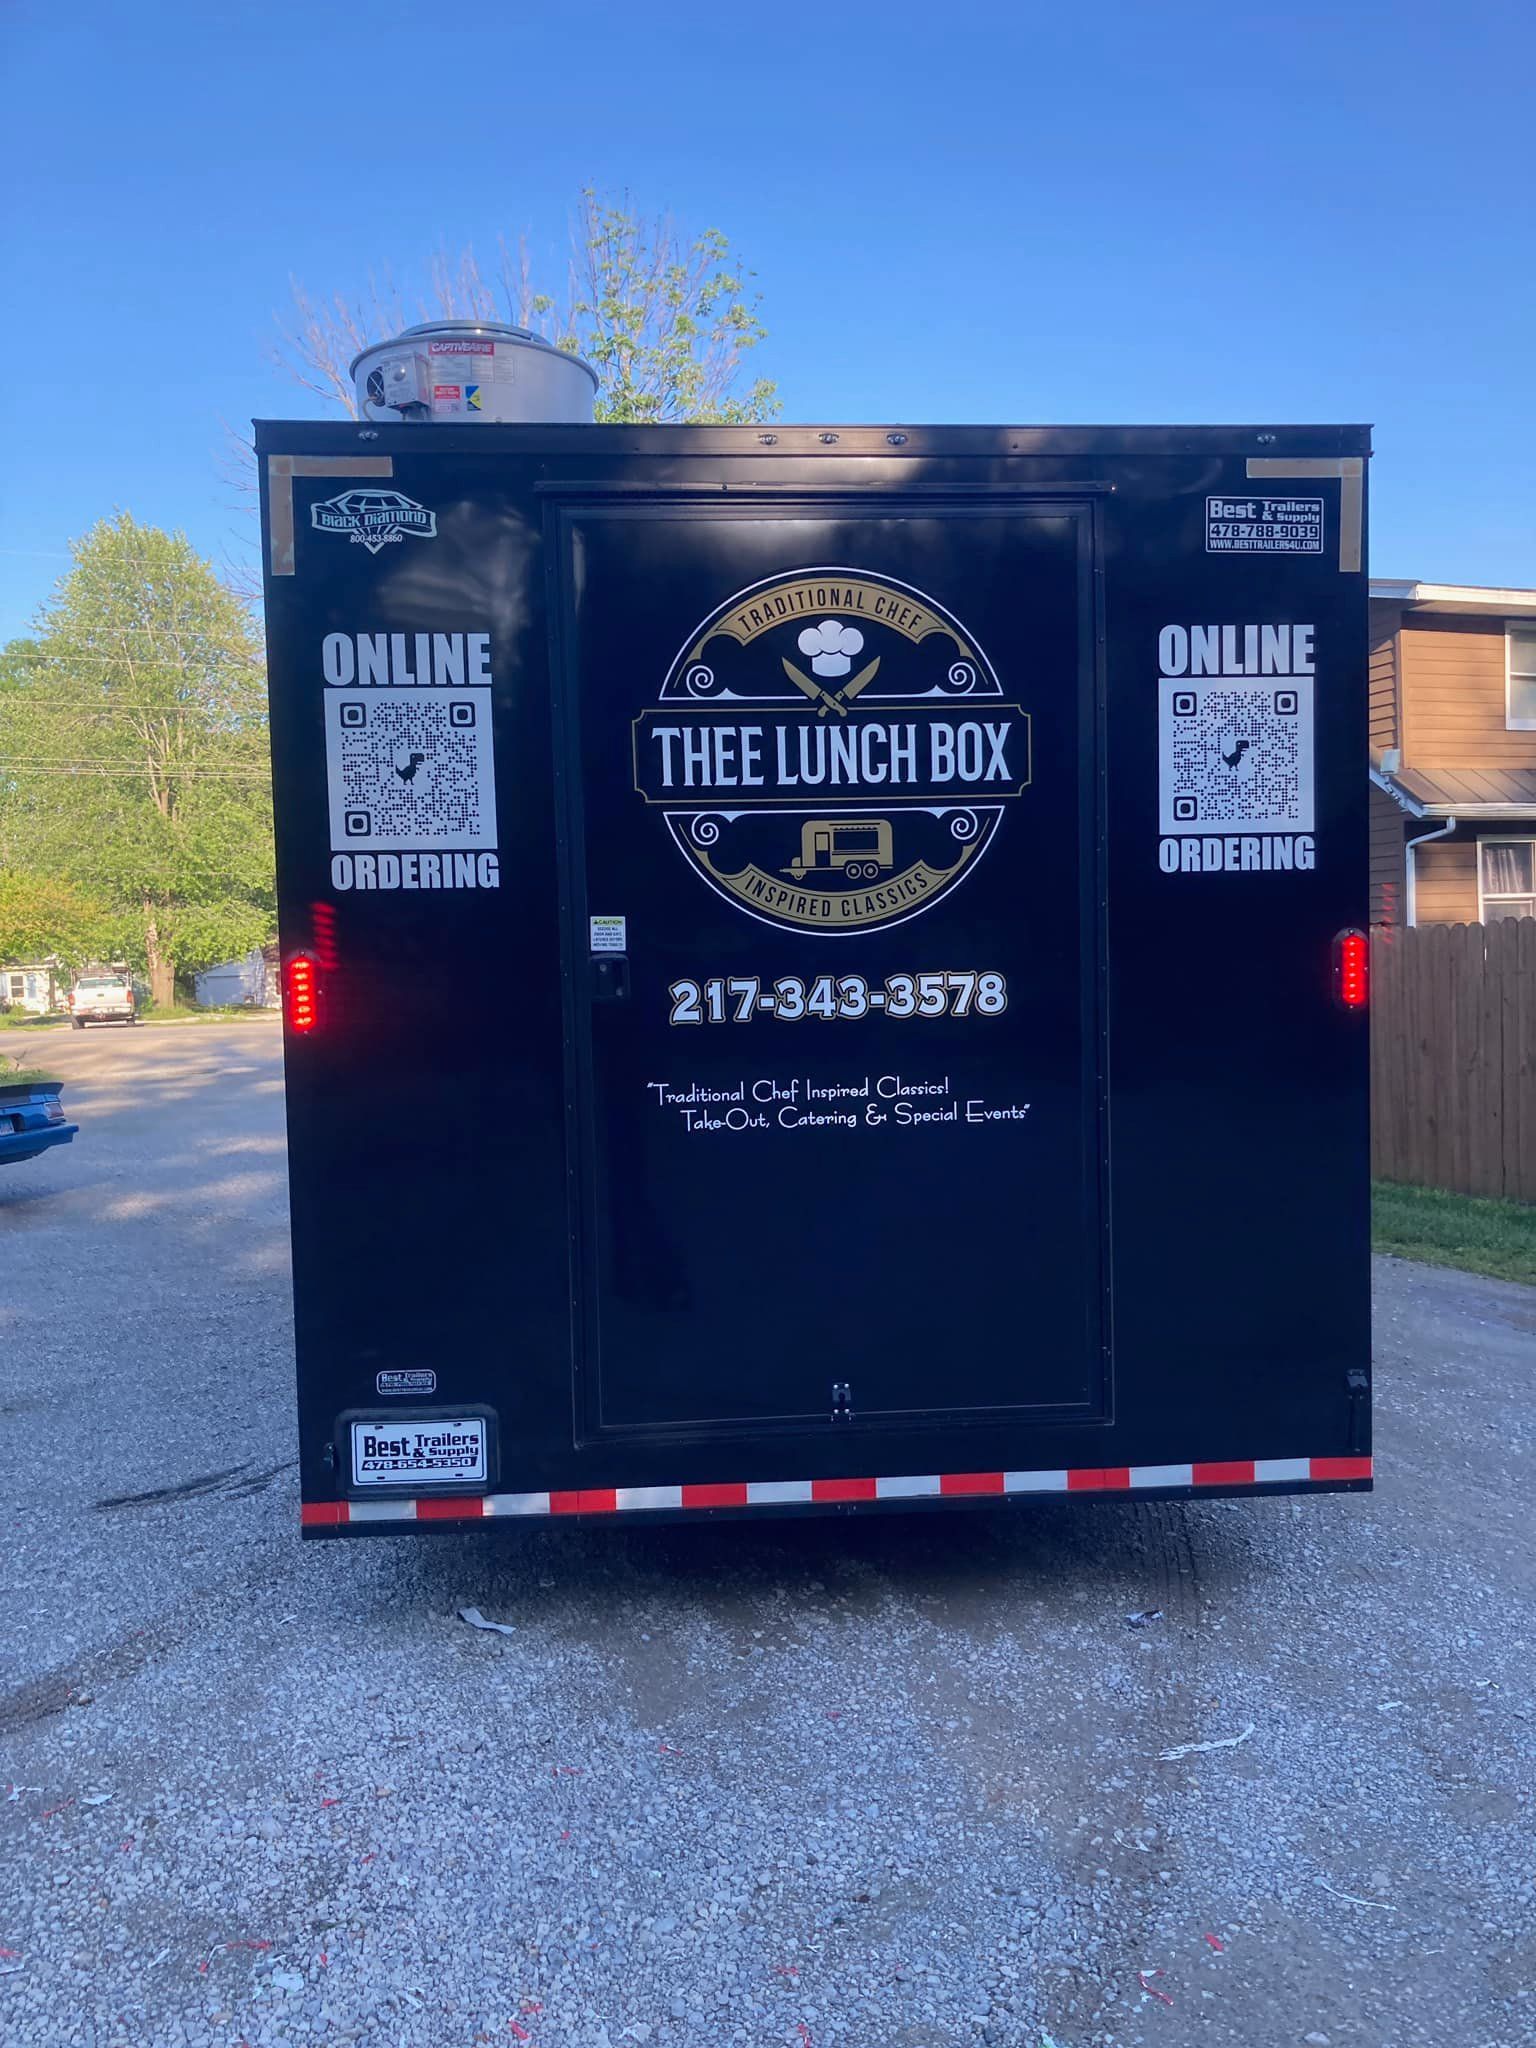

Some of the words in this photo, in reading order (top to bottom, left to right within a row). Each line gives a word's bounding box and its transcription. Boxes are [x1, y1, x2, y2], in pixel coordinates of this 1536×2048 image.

[1210, 500, 1256, 518] Best
[1262, 501, 1320, 512] Trailers
[1262, 511, 1273, 520] &
[1277, 512, 1320, 523] Supply
[1210, 524, 1319, 538] 478-788-9039
[1210, 540, 1320, 550] WWW.BESTTRAILERS4U.COM
[738, 588, 865, 633] TRADITIONAL
[874, 596, 922, 630] CHEF
[322, 632, 493, 686] ONLINE
[1159, 624, 1315, 676] ONLINE
[651, 726, 764, 786] THEE
[775, 723, 917, 785] LUNCH
[929, 722, 1013, 781] BOX
[1159, 835, 1315, 873] ORDERING
[331, 853, 500, 890] ORDERING
[744, 874, 831, 917] INSPIRED
[841, 871, 928, 917] CLASSICS
[670, 972, 1007, 1025] 217-343-3578
[752, 1079, 799, 1103] Chef
[807, 1076, 869, 1101] Inspired
[877, 1076, 949, 1098] Classics!
[680, 1108, 770, 1132] Take-Out,
[778, 1105, 857, 1128] Catering
[865, 1103, 887, 1126] &
[894, 1101, 957, 1125] Special
[382, 1373, 402, 1382] Best
[364, 1436, 410, 1457] Best
[414, 1433, 479, 1447] Trailers
[413, 1448, 425, 1458] &
[429, 1446, 479, 1457] Supply
[363, 1458, 472, 1470] 478-654-5350
